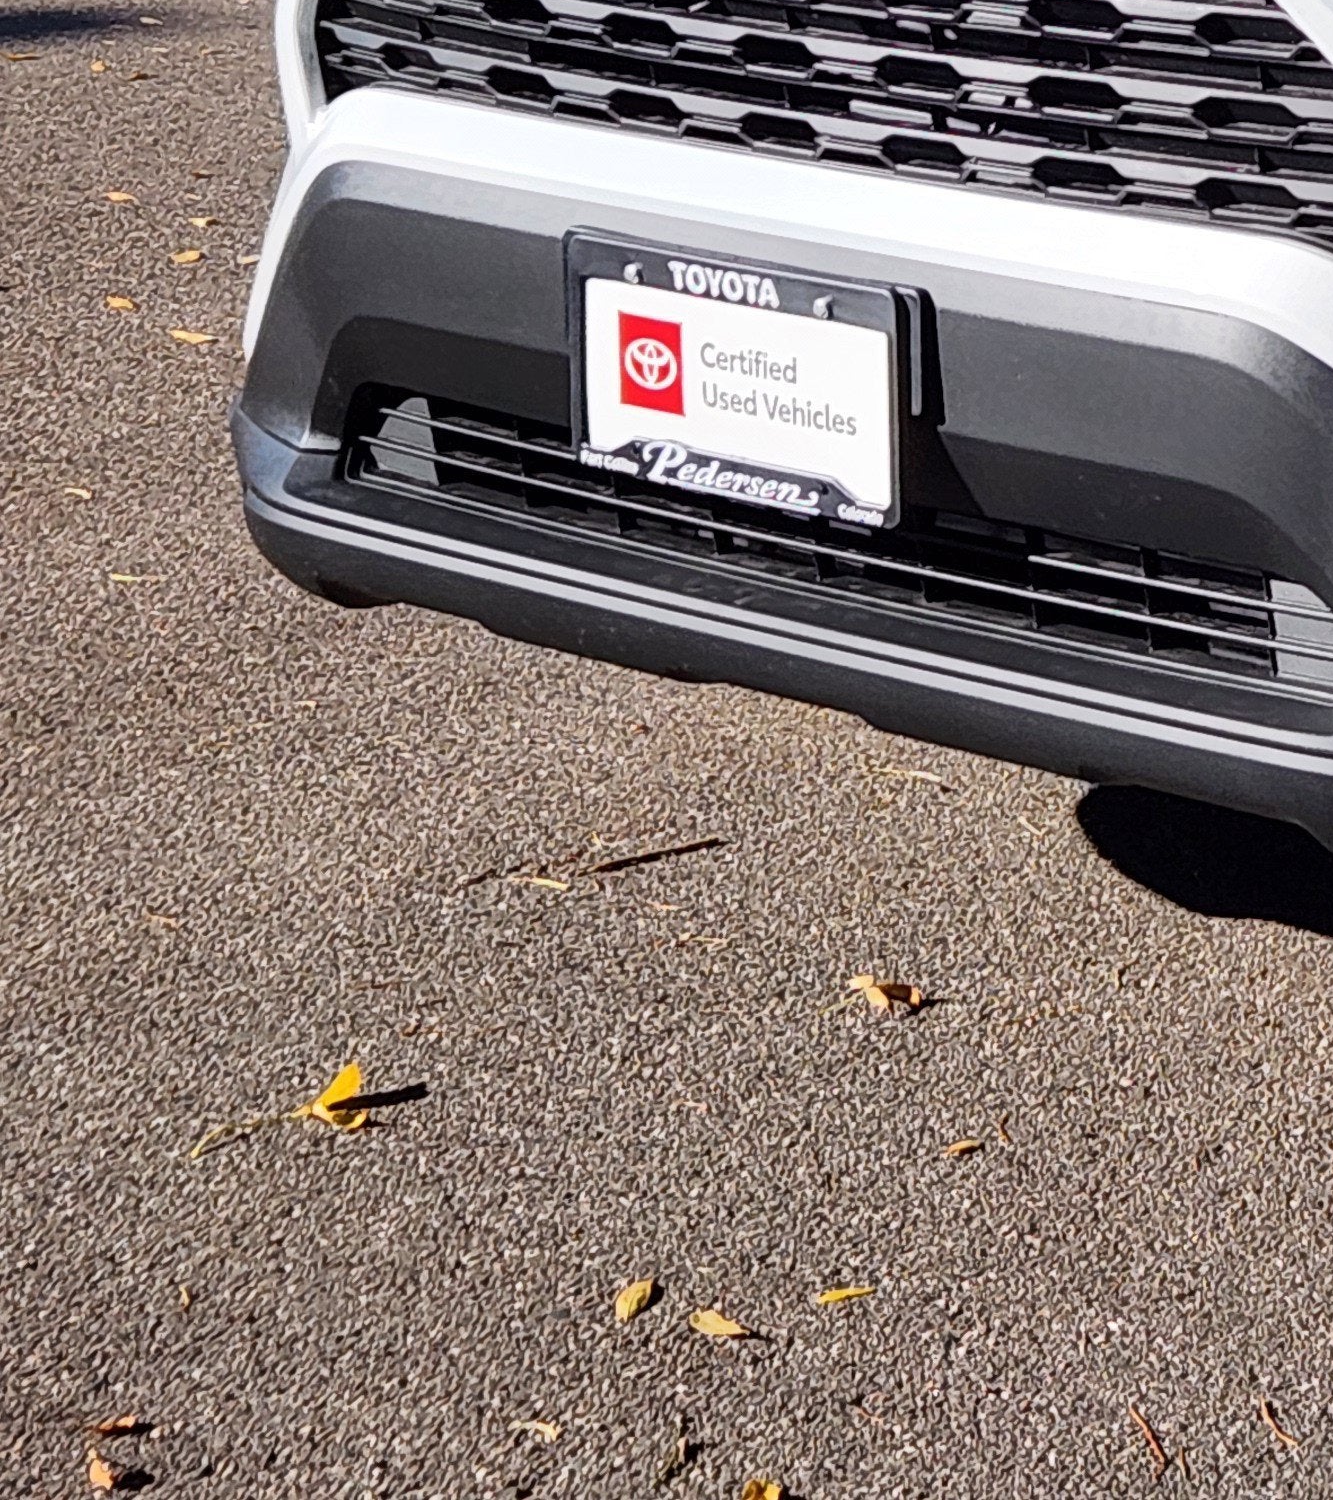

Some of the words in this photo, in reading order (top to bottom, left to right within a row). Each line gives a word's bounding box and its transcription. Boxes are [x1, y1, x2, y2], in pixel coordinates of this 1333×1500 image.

[669, 260, 781, 309] TOYOTA
[700, 342, 797, 384] Certified
[702, 381, 757, 416] Used
[762, 393, 857, 436] Vehicles
[642, 440, 819, 507] Pedersen
